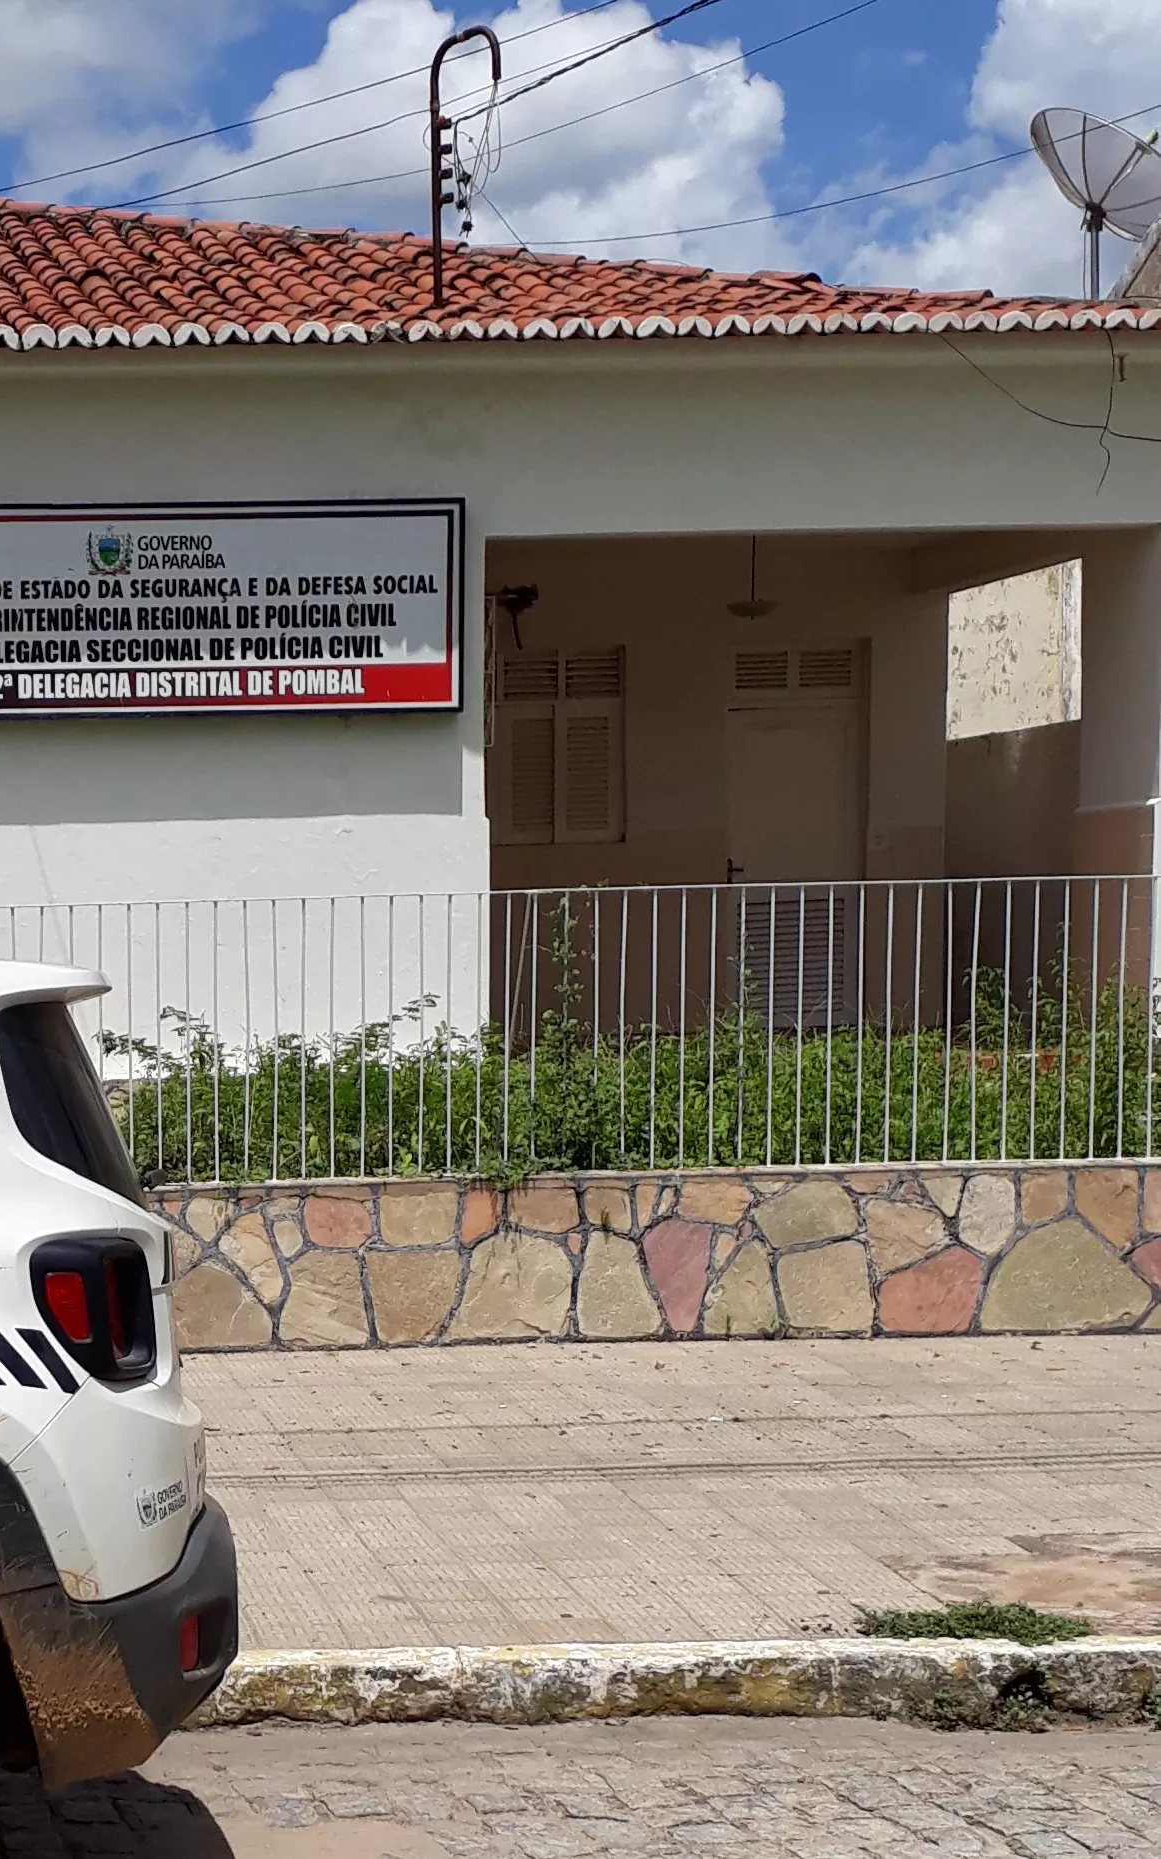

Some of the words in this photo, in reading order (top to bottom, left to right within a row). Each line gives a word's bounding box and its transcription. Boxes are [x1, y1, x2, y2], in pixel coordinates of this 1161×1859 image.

[138, 535, 212, 551] GOVERNO
[138, 554, 159, 570] DA
[162, 550, 226, 569] PARAÍBA
[20, 579, 90, 600] ESTADO
[98, 579, 123, 599] DA
[130, 577, 241, 602] SEGURANÇA
[249, 578, 258, 596] E
[265, 577, 291, 596] DA
[298, 575, 366, 596] DEFESA
[373, 574, 438, 594] SOCIAL
[138, 605, 231, 631] REGIONAL
[236, 605, 260, 629] DE
[265, 600, 341, 629] POLÍCIA
[346, 603, 396, 628] CIVIL
[86, 637, 204, 663] SECCIONAL
[209, 637, 235, 661] DE
[240, 632, 322, 660] POLÍCIA
[329, 635, 383, 659] CIVIL
[18, 672, 131, 699] DELEGACIA
[136, 670, 242, 698] DISTRITAL
[247, 669, 273, 696] DE
[278, 668, 365, 696] POMBAL
